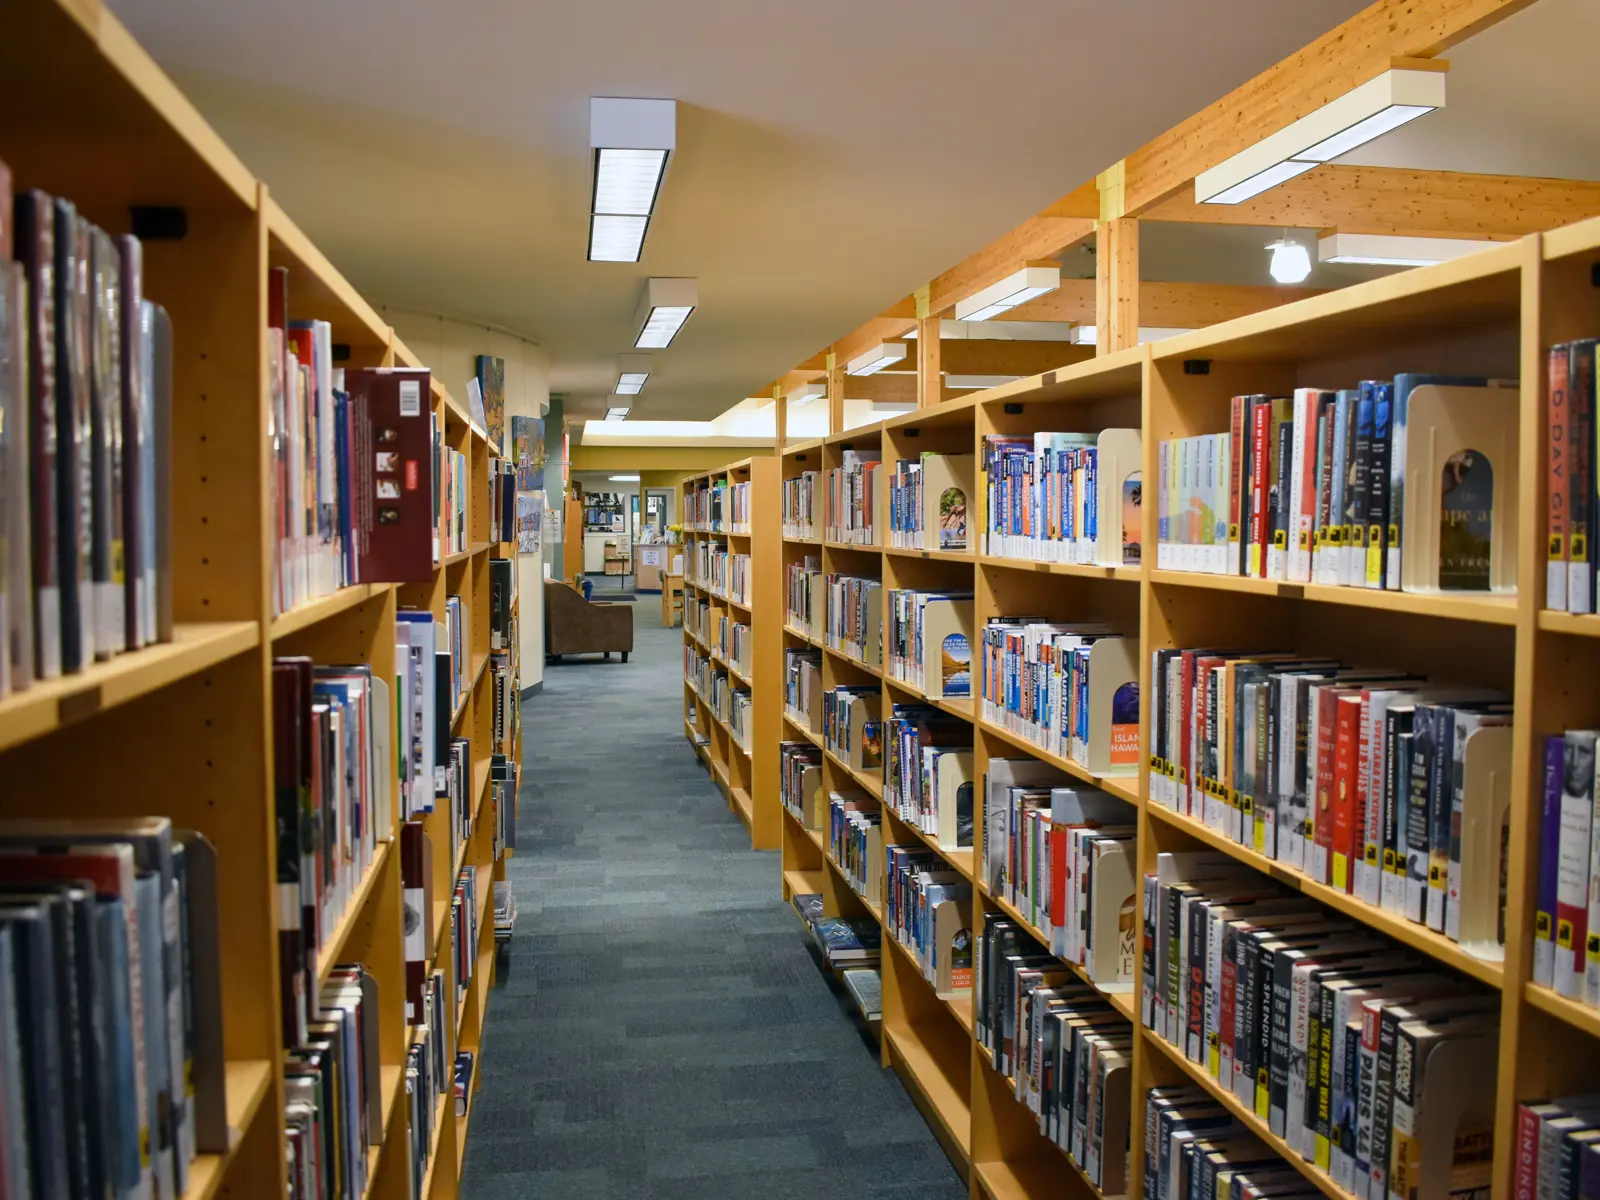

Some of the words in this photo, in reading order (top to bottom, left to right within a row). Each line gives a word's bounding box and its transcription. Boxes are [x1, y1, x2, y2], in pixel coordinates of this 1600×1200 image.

[1552, 390, 1564, 479] D-DAY
[1061, 668, 1069, 732] Australia
[1196, 665, 1205, 720] MENGELE
[1111, 743, 1139, 752] HAWA
[1114, 734, 1140, 742] ISLAN
[1358, 760, 1368, 793] SPIES
[1236, 940, 1245, 966] JUNO
[1167, 962, 1178, 1003] DIEP
[1235, 983, 1244, 1001] TED
[1190, 967, 1203, 1036] D-DAY
[1246, 971, 1254, 1034] SPLENDID
[1261, 983, 1271, 1048] SPLENDID
[1275, 999, 1288, 1013] THE
[1296, 980, 1307, 1046] NORMANDY
[1235, 1003, 1243, 1039] BARRIS
[1275, 1015, 1287, 1028] SEA
[1321, 1027, 1331, 1047] THE
[1380, 1020, 1394, 1045] ON
[1272, 1043, 1288, 1059] ALIVE
[1319, 1049, 1330, 1085] FIRST
[1378, 1050, 1393, 1073] TO
[1243, 1063, 1252, 1077] VI
[1359, 1054, 1374, 1118] PARIS
[1402, 1039, 1414, 1100] ANTONY
[1319, 1086, 1329, 1122] WAVE
[1161, 1121, 1169, 1157] DAM
[1373, 1078, 1391, 1168] VICTORY
[1396, 1164, 1406, 1199] BATT
